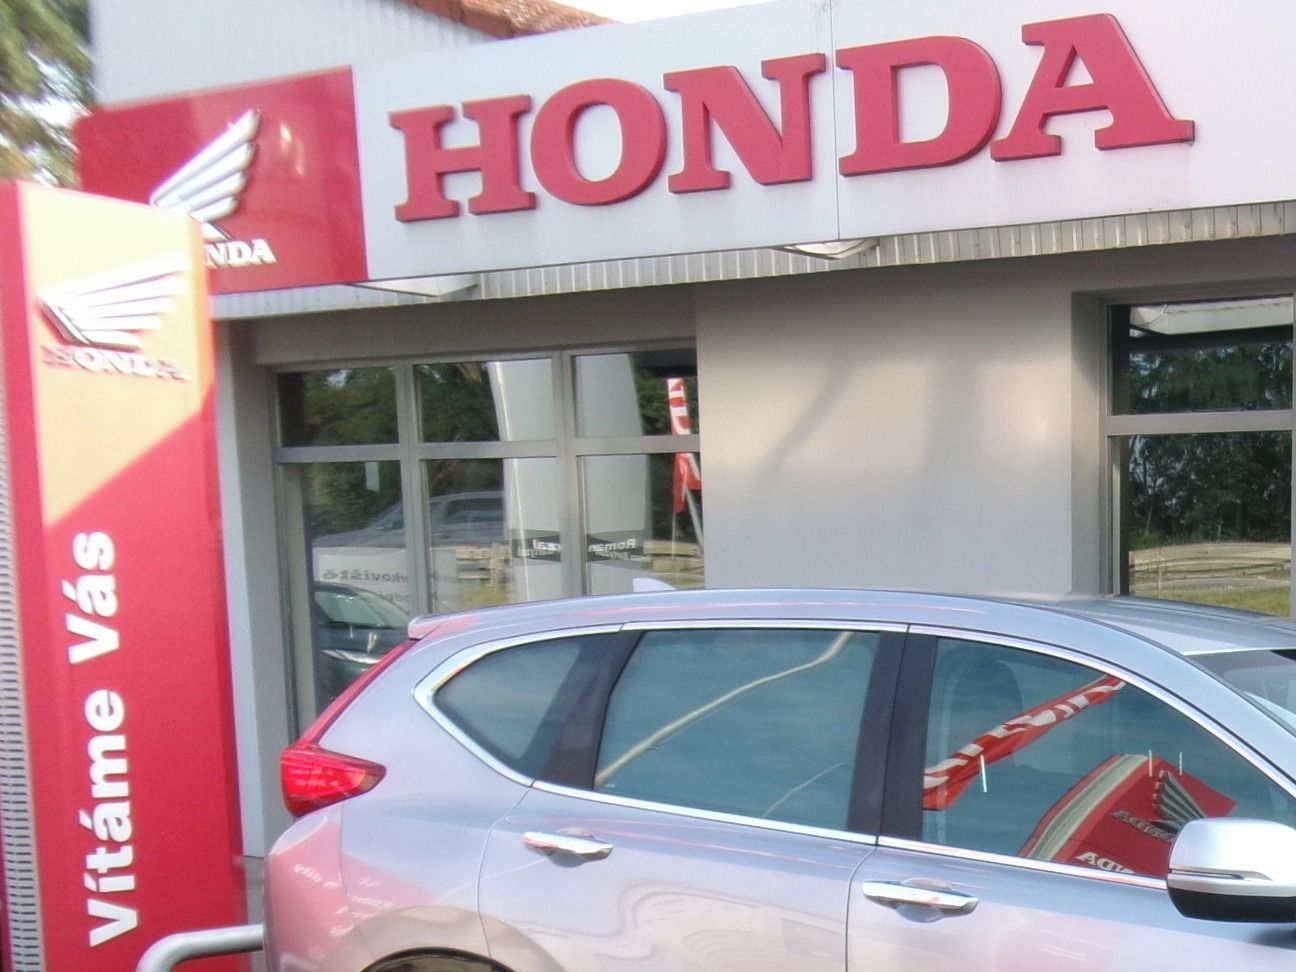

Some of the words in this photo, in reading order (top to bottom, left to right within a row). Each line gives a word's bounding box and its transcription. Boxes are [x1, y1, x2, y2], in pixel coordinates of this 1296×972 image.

[389, 13, 1195, 223] HONDA
[204, 238, 277, 271] NDA
[60, 530, 120, 666] Vás
[79, 689, 139, 948] Vítáme
